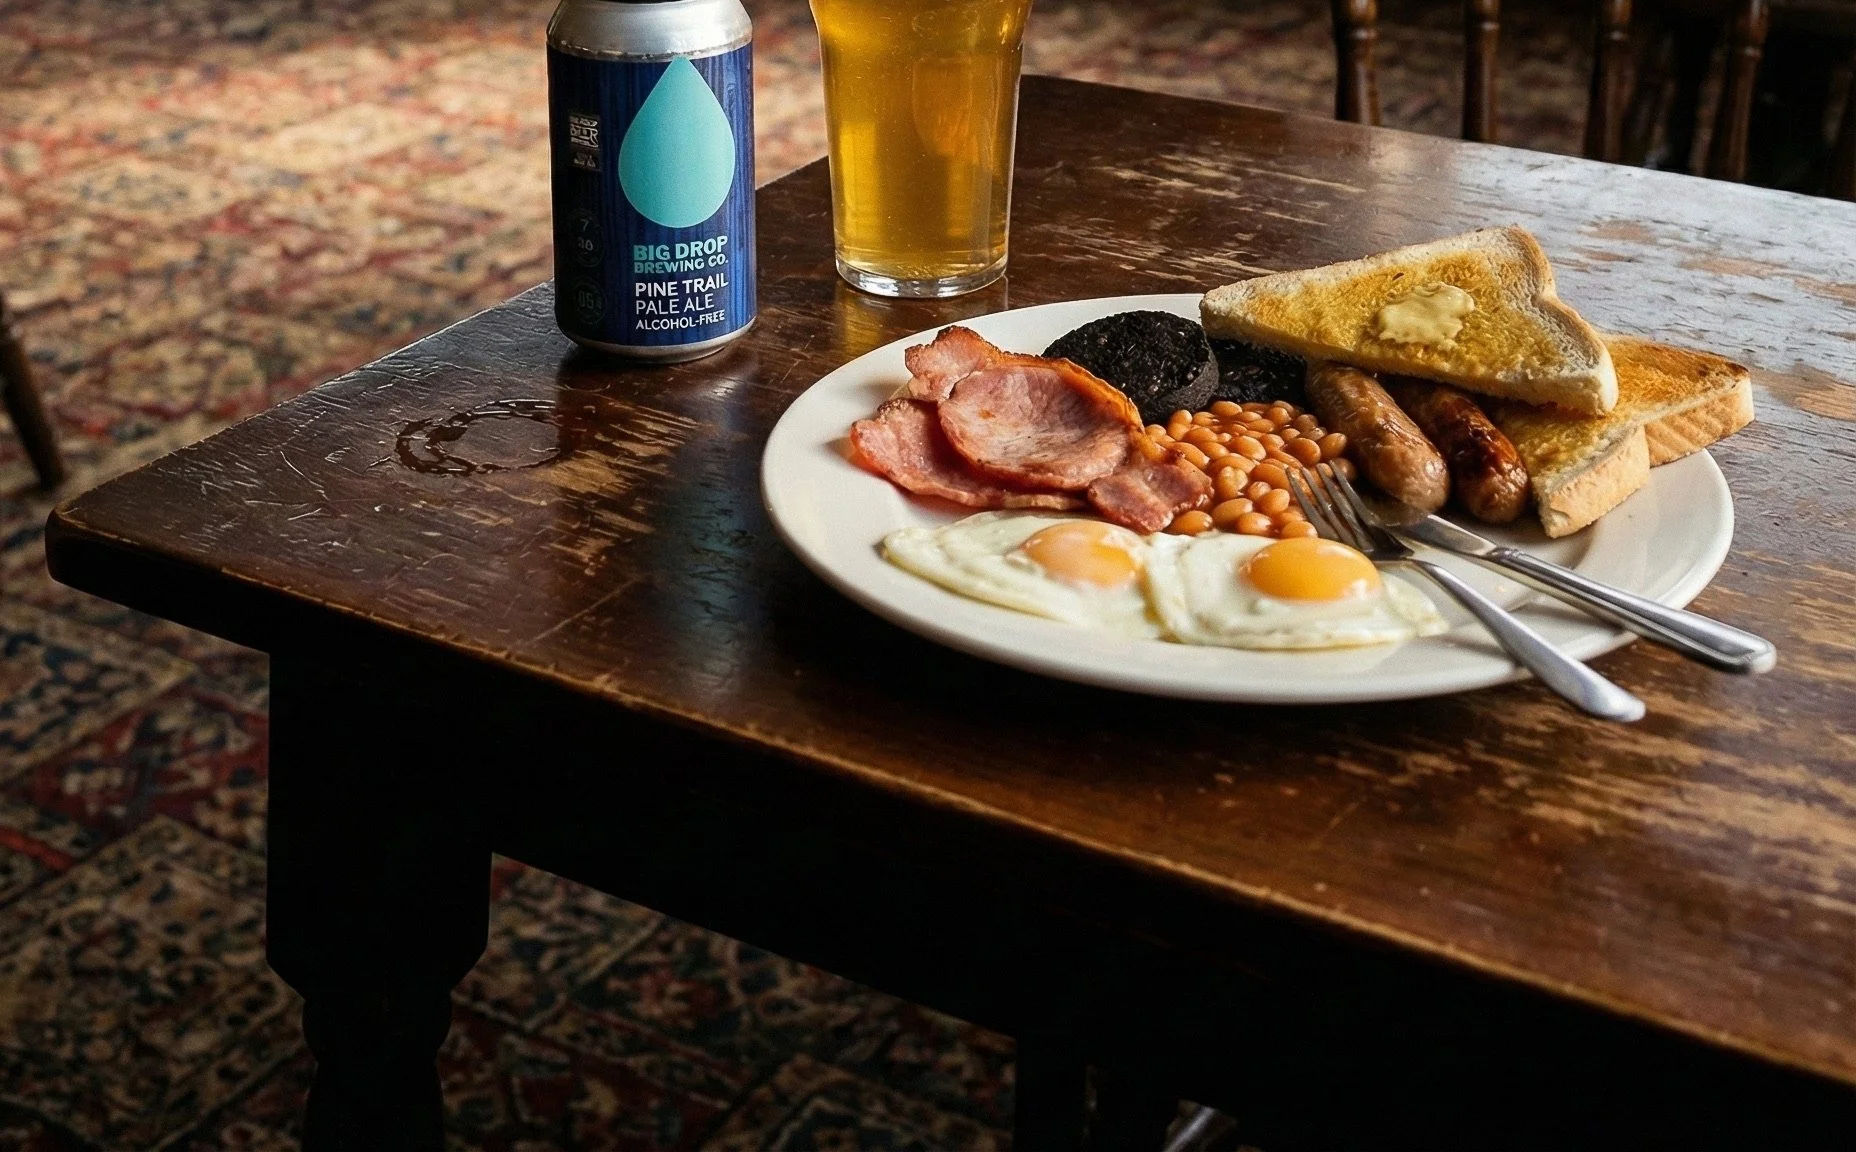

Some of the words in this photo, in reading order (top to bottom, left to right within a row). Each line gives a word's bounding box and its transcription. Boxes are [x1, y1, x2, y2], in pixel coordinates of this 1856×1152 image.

[633, 244, 671, 261] BIG
[675, 235, 728, 259] DROP
[634, 258, 705, 274] BREWING
[708, 253, 729, 268] CO.
[635, 281, 678, 297] PINE
[682, 273, 729, 294] TRAIL
[636, 298, 680, 315] PALE
[683, 293, 715, 313] ALE
[635, 309, 726, 331] ALCOHOL-FREE
